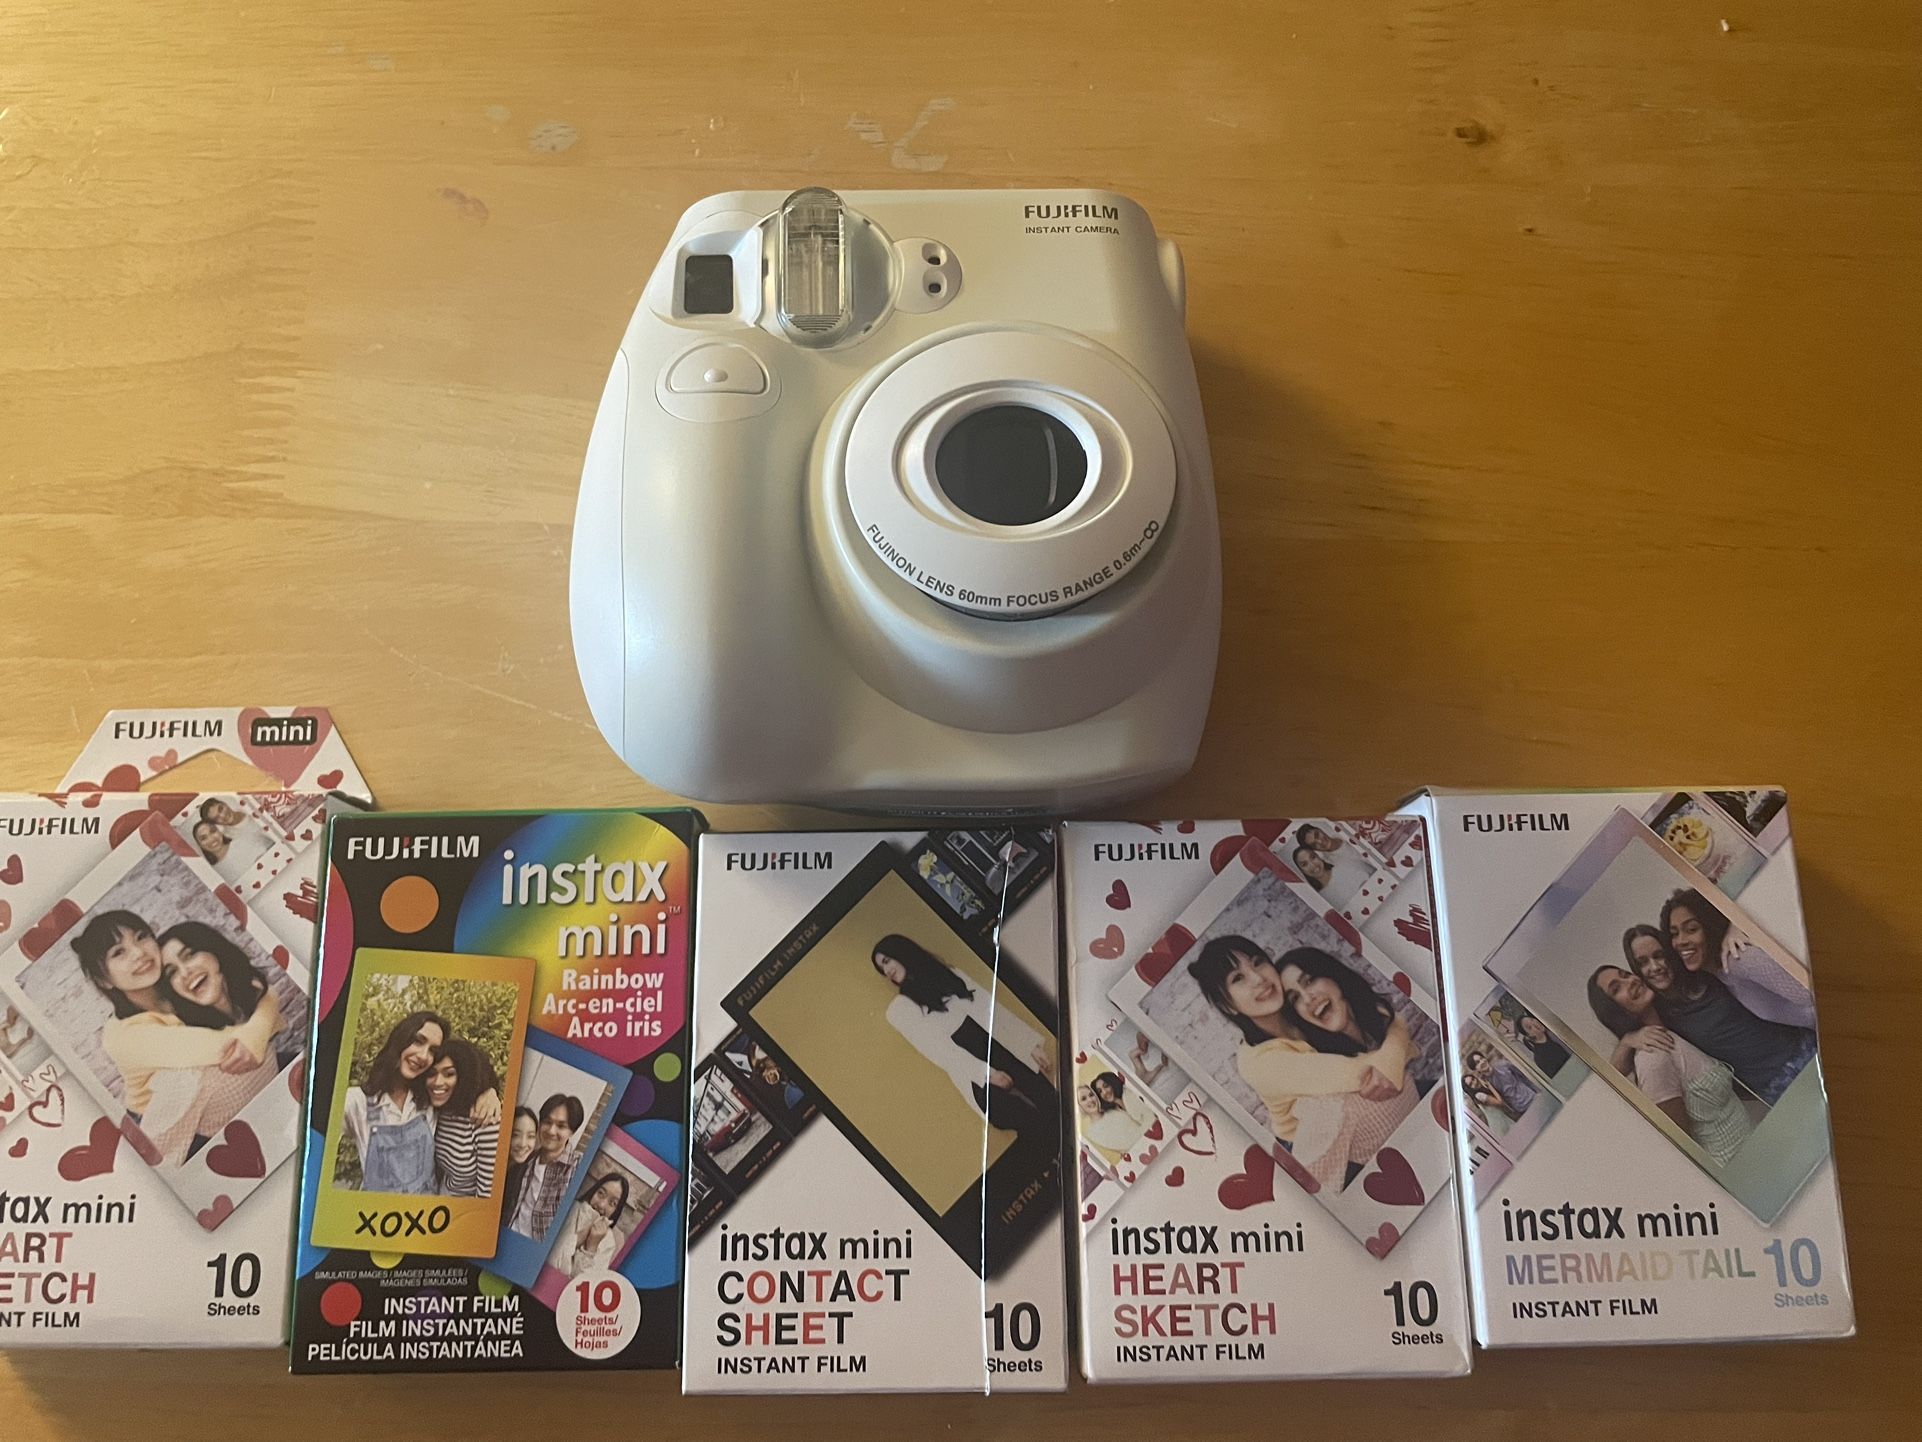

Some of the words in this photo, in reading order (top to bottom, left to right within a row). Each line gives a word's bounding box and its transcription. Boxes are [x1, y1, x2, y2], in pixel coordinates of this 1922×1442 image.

[1024, 204, 1119, 220] FUJIFILM
[1025, 226, 1071, 234] INSTANT
[1075, 226, 1120, 235] CAMERA
[867, 523, 917, 577] FUJINON
[916, 571, 955, 597] LENS
[958, 589, 1002, 607] 60mm
[1006, 590, 1059, 607] FOCUS
[1063, 566, 1114, 599] RANGE
[114, 719, 223, 739] FUJIFILM
[256, 720, 314, 742] mini
[1462, 812, 1570, 832] FUJIFILM
[347, 835, 480, 859] FUJIFILM
[1093, 842, 1200, 861] FUJIFILM
[726, 851, 833, 871] FUJIFILM
[501, 849, 669, 905] instax
[558, 912, 667, 957] mini
[562, 968, 664, 990] Rainbow
[542, 992, 663, 1015] Arc-en-ciel
[567, 1017, 617, 1038] Arco
[626, 1015, 662, 1037] iris
[0, 1190, 52, 1224] tax
[62, 1194, 136, 1224] mini
[1001, 1179, 1042, 1224] INSTAX
[355, 1205, 451, 1238] XOXO
[1502, 1198, 1625, 1242] instax
[1637, 1202, 1719, 1238] mini
[0, 1231, 73, 1263] ART
[720, 1224, 828, 1261] instax
[839, 1228, 912, 1259] mini
[1111, 1217, 1219, 1255] instax
[1230, 1222, 1304, 1253] mini
[1505, 1250, 1674, 1286] MERMAID
[1677, 1247, 1757, 1281] TAIL
[1763, 1237, 1822, 1289] 10
[0, 1271, 96, 1304] ETCH
[207, 1252, 262, 1299] 10
[717, 1268, 910, 1304] CONTACT
[1112, 1261, 1246, 1296] HEART
[207, 1302, 260, 1316] Sheets
[384, 1296, 467, 1315] INSTANT
[473, 1295, 519, 1313] FILM
[575, 1280, 621, 1314] 10
[1383, 1280, 1438, 1327] 10
[1512, 1300, 1602, 1319] INSTANT
[1609, 1298, 1658, 1316] FILM
[1773, 1292, 1829, 1308] Sheets
[32, 1311, 80, 1328] FILM
[349, 1320, 396, 1338] FILM
[402, 1313, 524, 1337] INSTANTANÉ
[575, 1314, 618, 1326] Sheets/
[716, 1311, 853, 1346] SHEET
[985, 1302, 1041, 1351] 10
[1114, 1302, 1277, 1338] SKETCH
[575, 1326, 622, 1338] Feuilles/
[1391, 1330, 1444, 1346] Sheets
[307, 1338, 395, 1361] PELÍCULA
[400, 1335, 523, 1359] INSTANTÁNEA
[574, 1338, 608, 1351] Hojas
[1116, 1345, 1208, 1362] INSTANT
[1215, 1343, 1265, 1360] FILM
[717, 1356, 810, 1374] INSTANT
[816, 1355, 867, 1373] FILM
[985, 1358, 1043, 1373] Sheets
